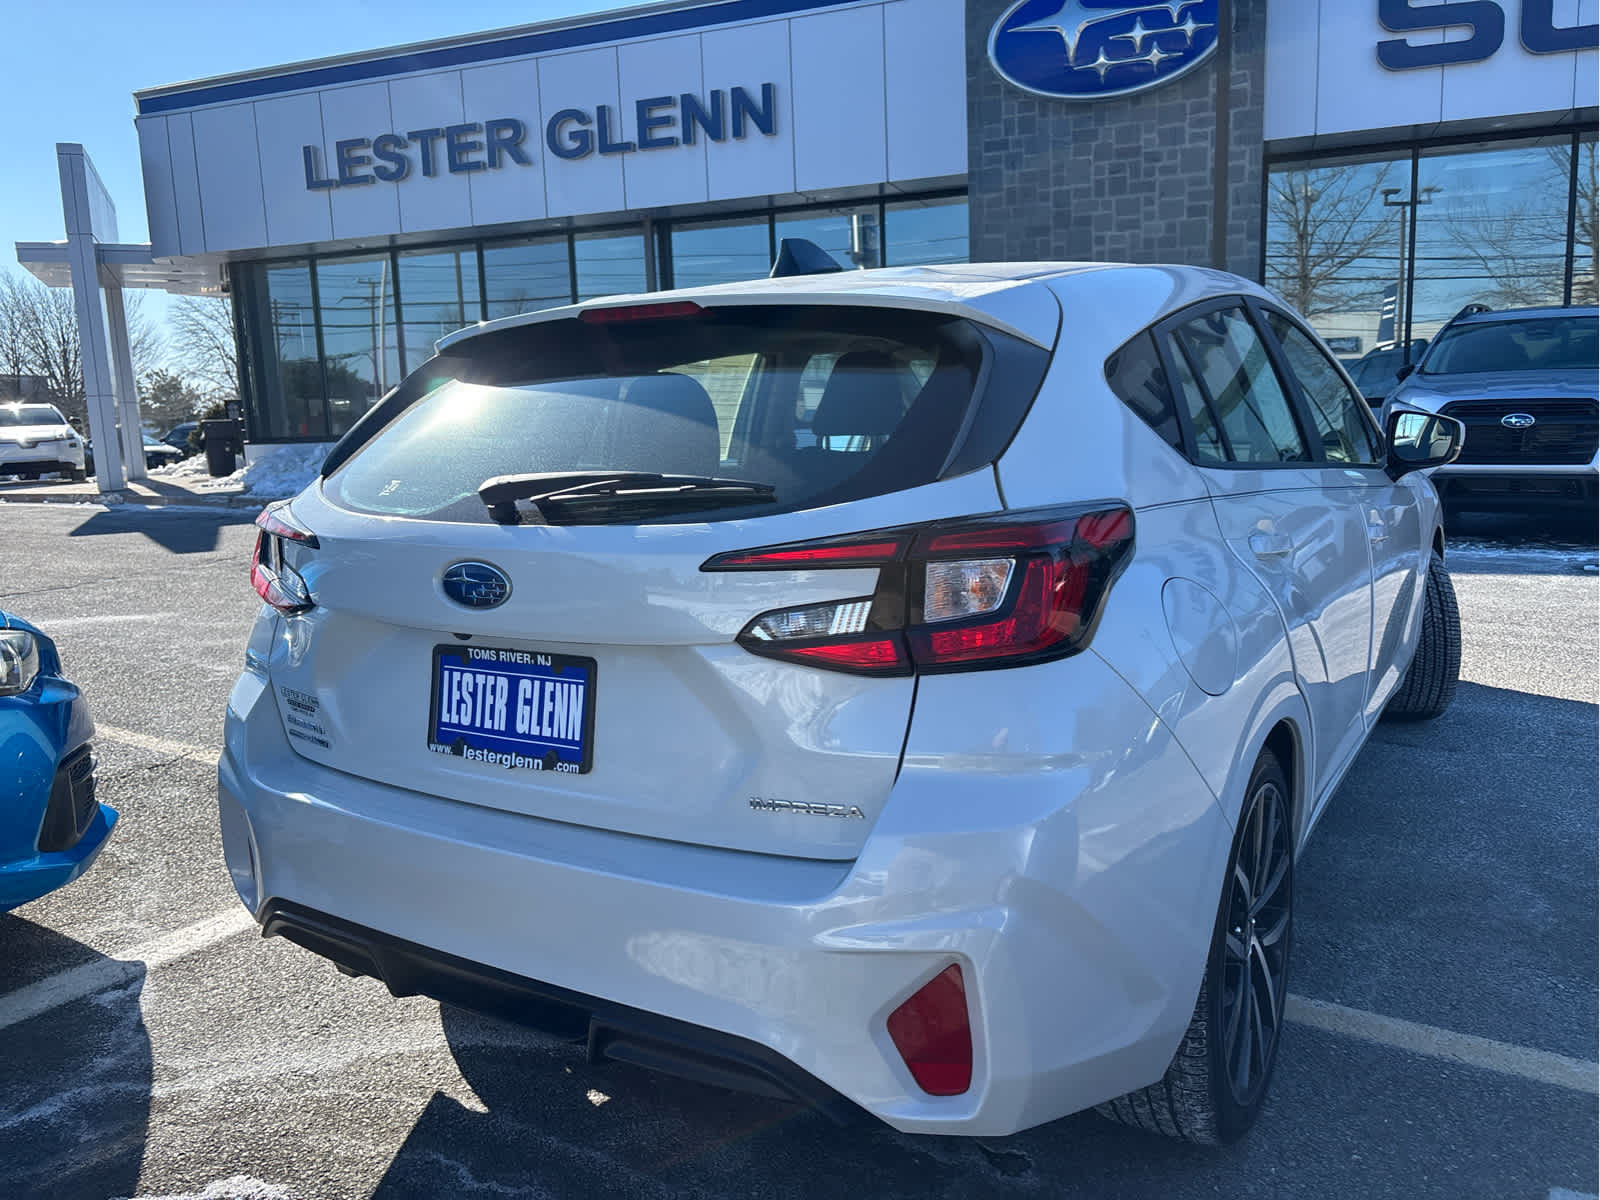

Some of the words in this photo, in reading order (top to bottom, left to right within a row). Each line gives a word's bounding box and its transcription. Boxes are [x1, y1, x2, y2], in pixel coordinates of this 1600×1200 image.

[303, 117, 532, 191] LESTER
[546, 82, 778, 160] GLENN
[467, 648, 496, 661] TOMS
[537, 655, 551, 666] NJ
[441, 670, 509, 731] LESTER
[515, 678, 584, 741] GLENN
[429, 743, 453, 755] www.
[463, 745, 543, 769] lesterglenn
[553, 761, 580, 773] .com
[749, 796, 865, 819] IMPREZA
